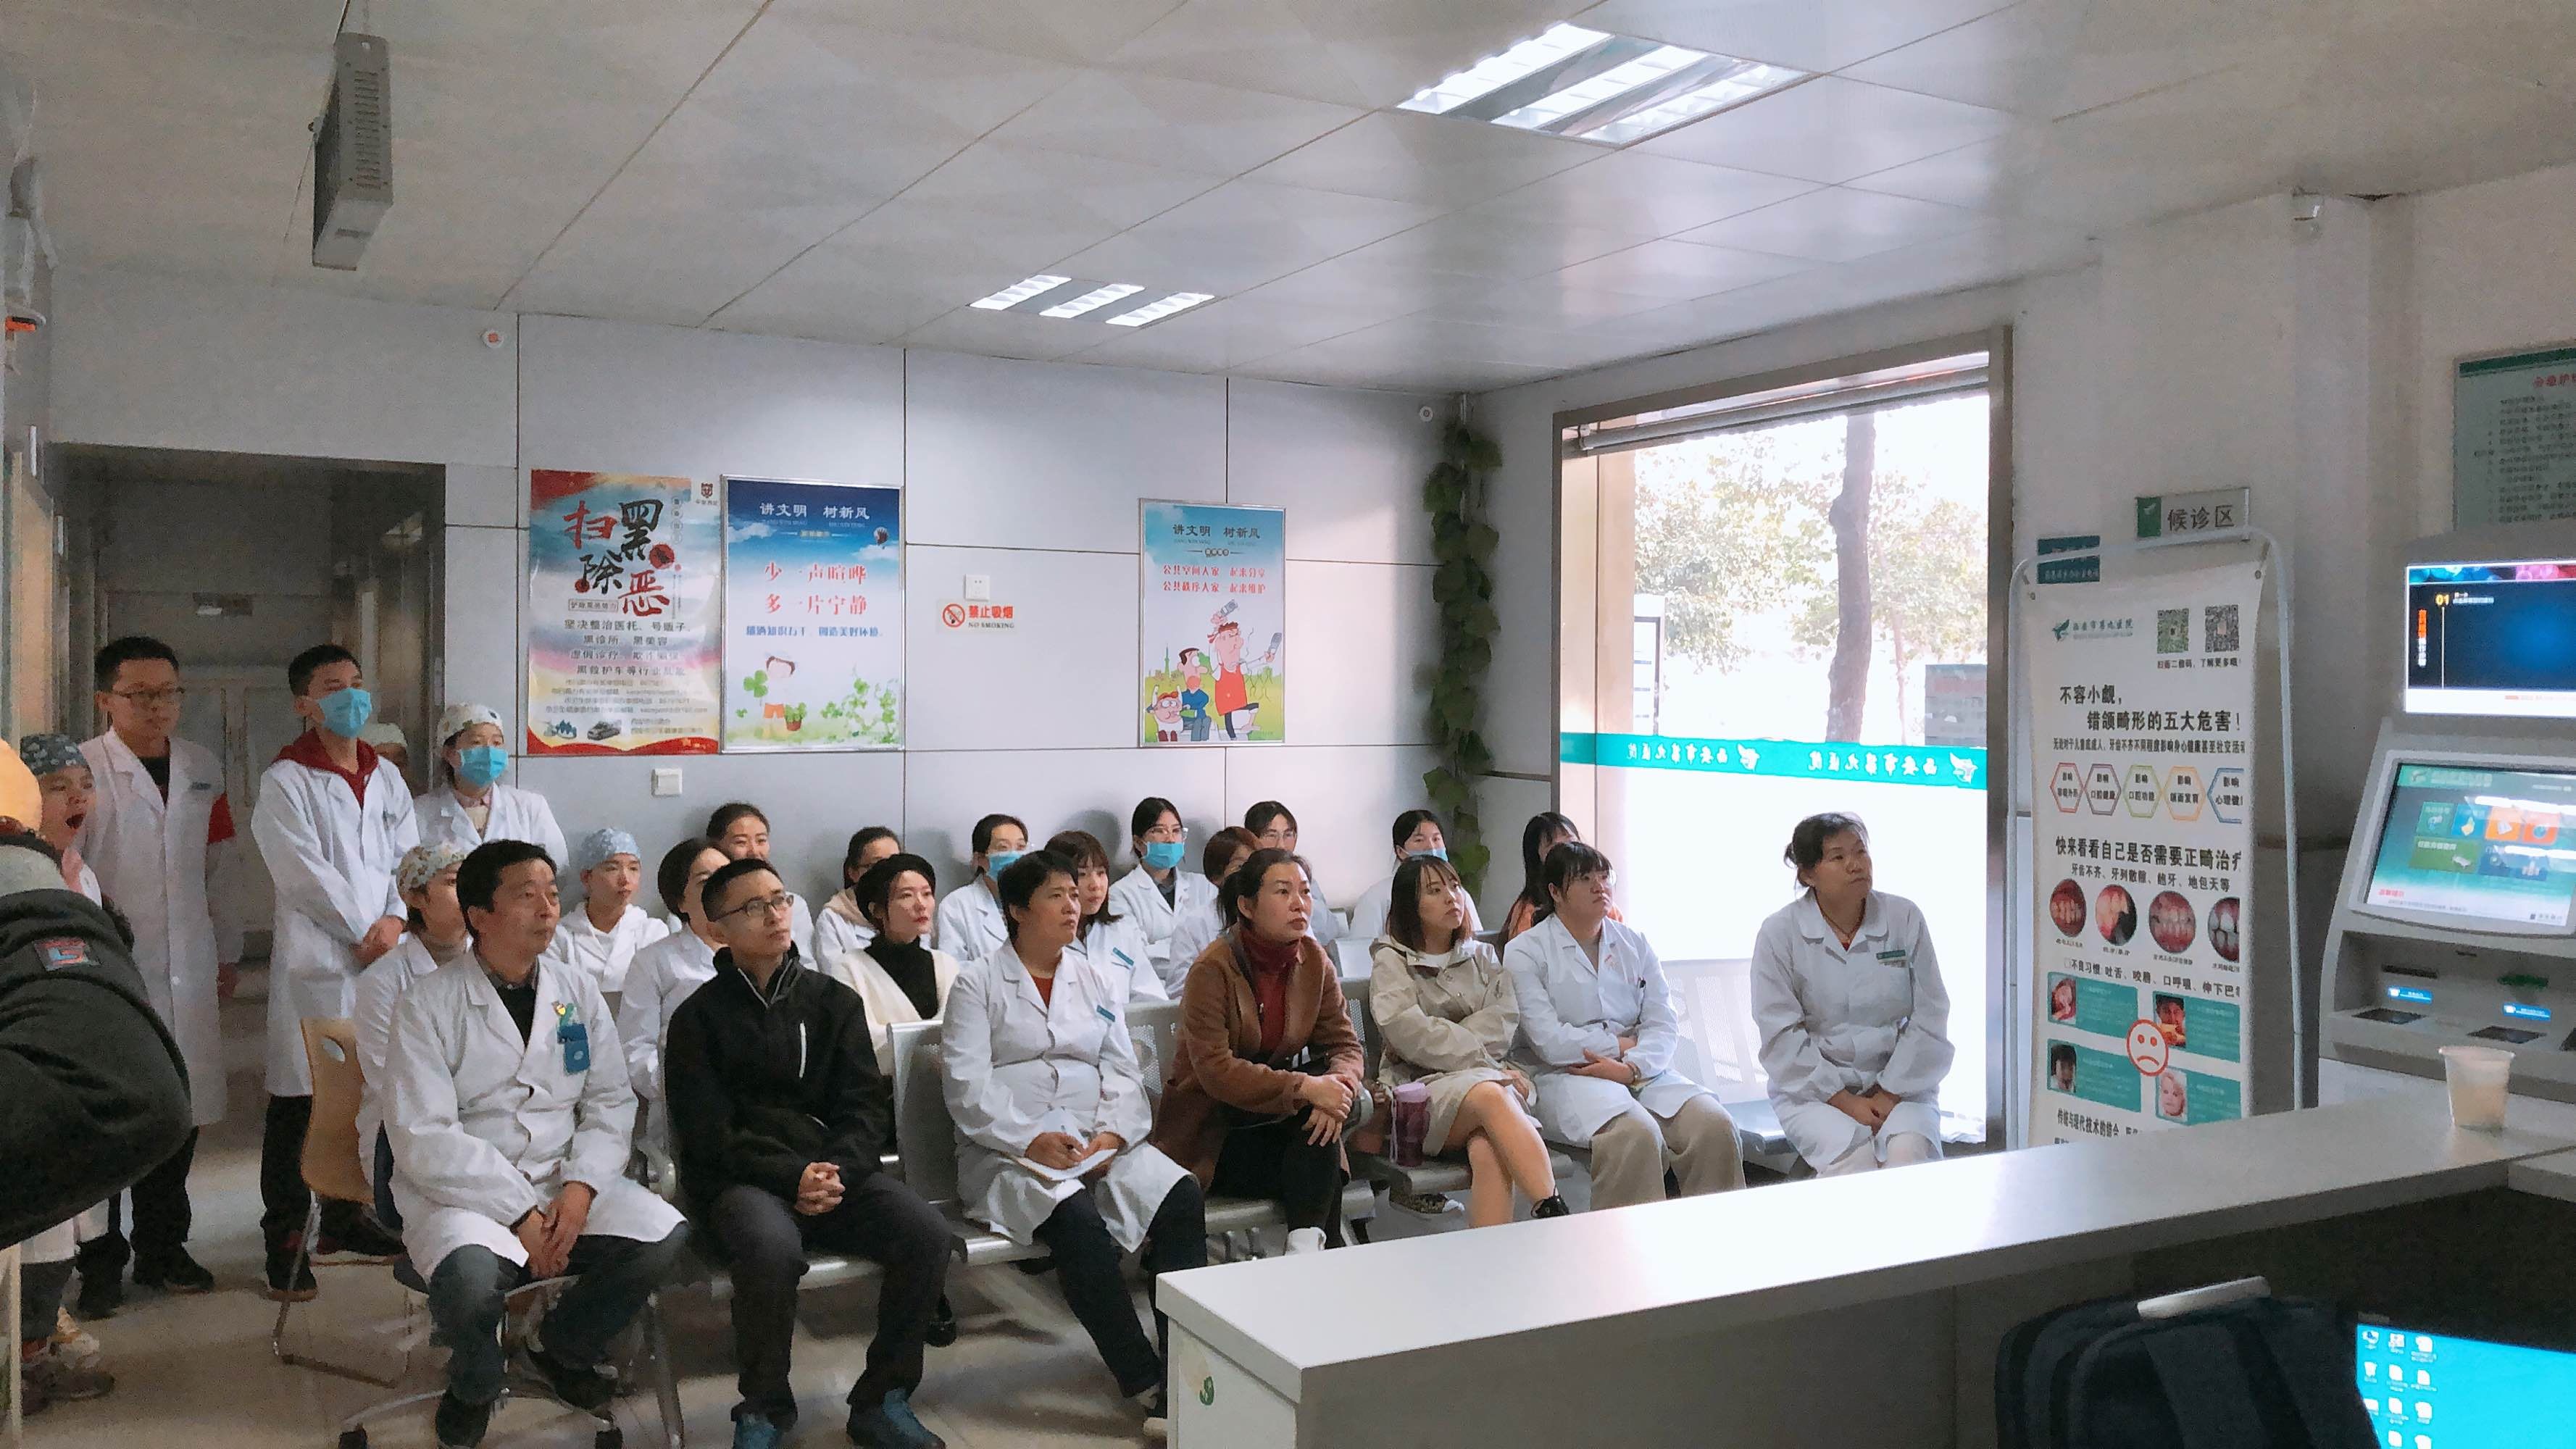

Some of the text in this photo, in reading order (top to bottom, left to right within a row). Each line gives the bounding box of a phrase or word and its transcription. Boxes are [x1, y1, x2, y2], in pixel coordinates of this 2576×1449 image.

[759, 502, 870, 520] 讲文明 树新风
[2167, 505, 2235, 532] 候诊区
[1172, 524, 1261, 539] 讲文明 树新风
[764, 562, 867, 585] 少声喧哗
[765, 593, 867, 615] 多片宁静
[2435, 594, 2449, 606] 01
[969, 605, 1014, 619] 禁止吸烟
[2215, 794, 2244, 806] 心理健
